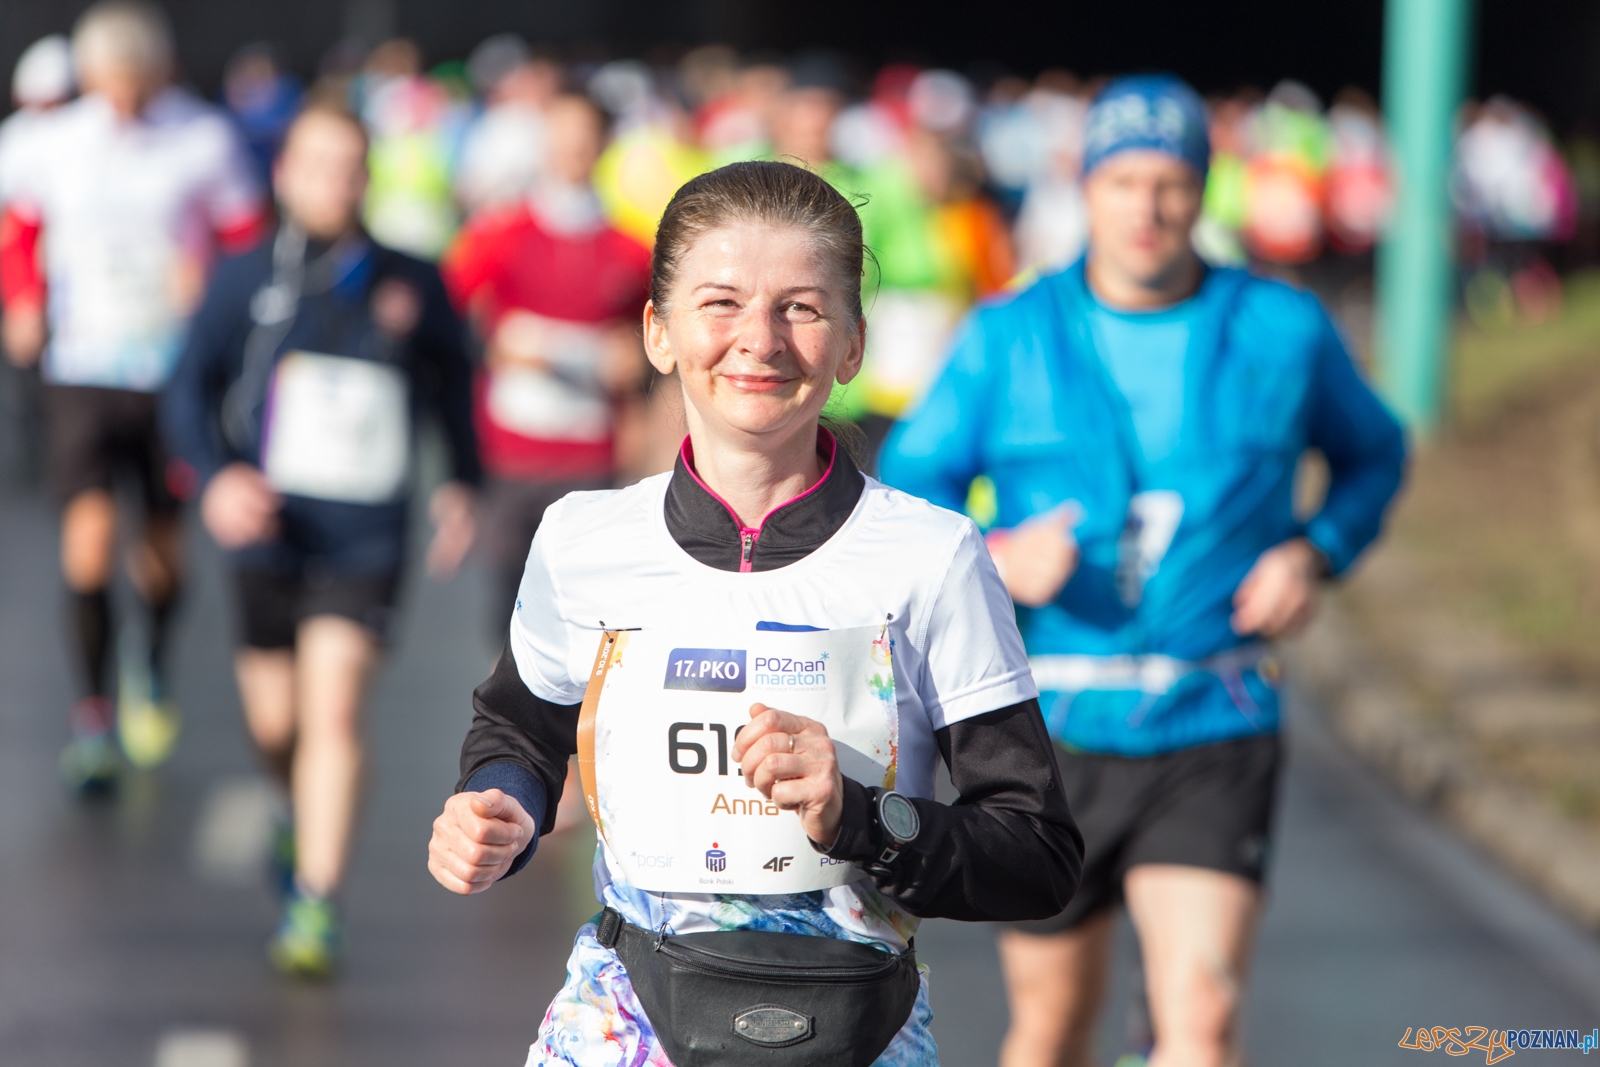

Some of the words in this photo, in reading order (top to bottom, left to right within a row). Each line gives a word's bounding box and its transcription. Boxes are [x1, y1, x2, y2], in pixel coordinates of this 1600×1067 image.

[674, 659, 696, 678] 17.
[699, 660, 740, 680] PKO
[755, 657, 825, 672] POZnan
[755, 672, 826, 686] maraton
[668, 721, 747, 776] 61
[710, 793, 779, 816] Anna
[637, 853, 674, 869] posir
[762, 855, 795, 872] 4F
